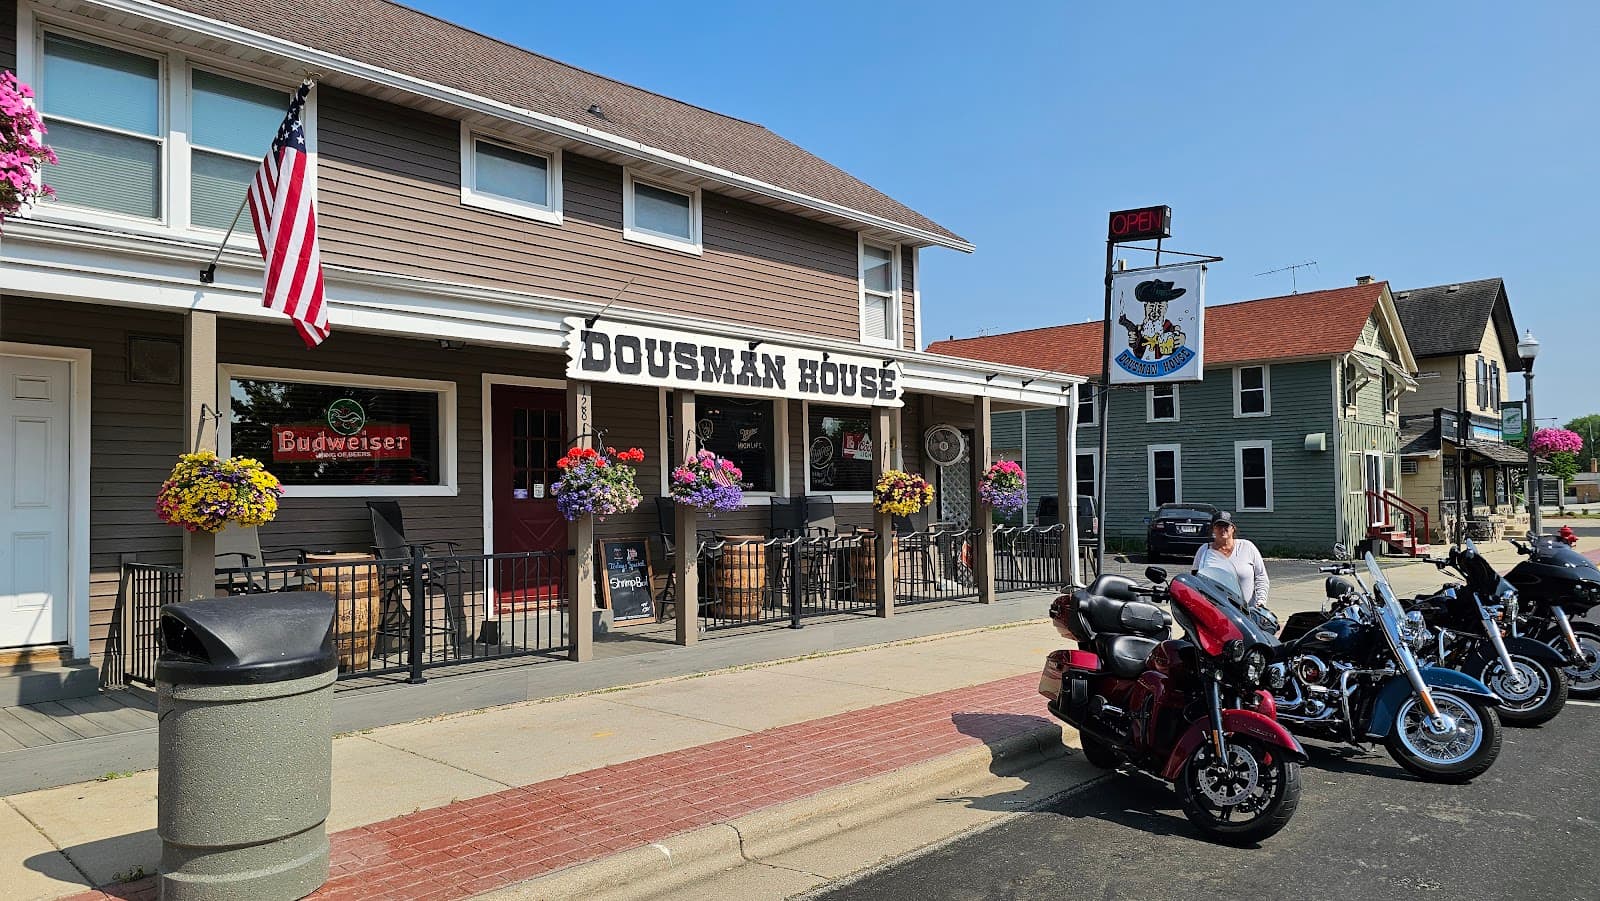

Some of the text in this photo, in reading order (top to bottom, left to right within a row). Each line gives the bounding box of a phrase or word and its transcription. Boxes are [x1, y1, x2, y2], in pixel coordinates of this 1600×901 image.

[1112, 209, 1161, 234] OPEN
[580, 330, 897, 399] DOUSMAN HOUSE
[1118, 349, 1191, 375] DOUSMAN HOUSE
[277, 430, 408, 452] Budweiser
